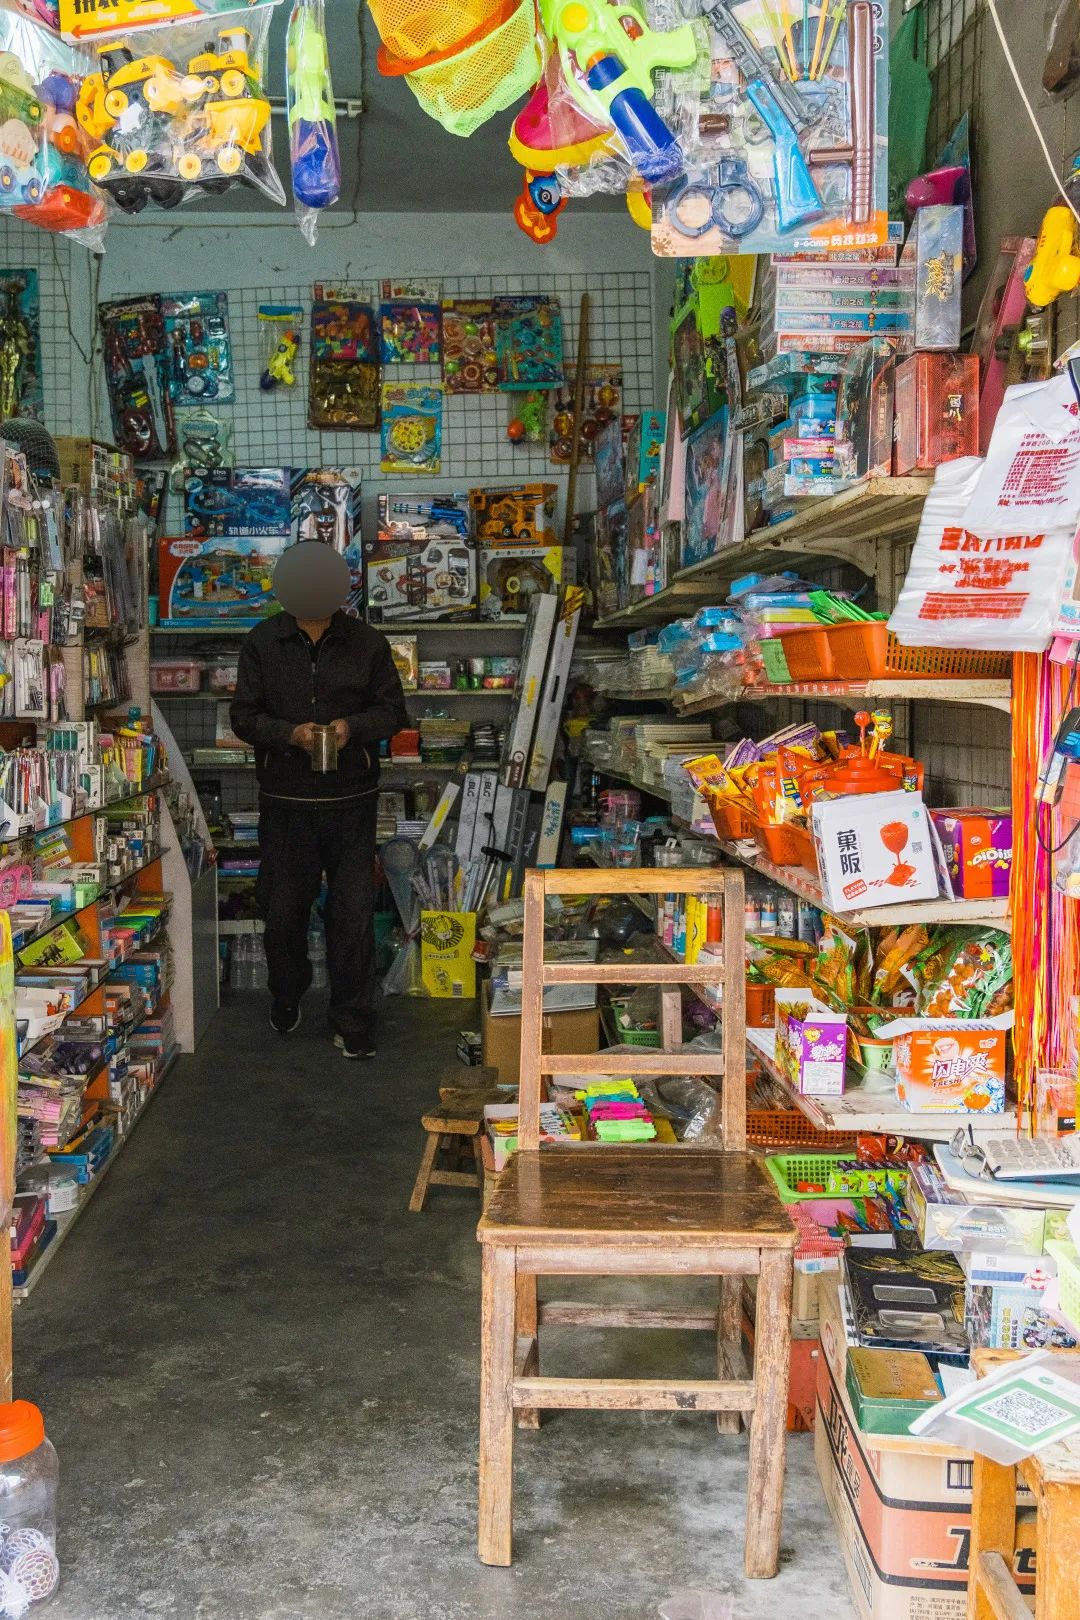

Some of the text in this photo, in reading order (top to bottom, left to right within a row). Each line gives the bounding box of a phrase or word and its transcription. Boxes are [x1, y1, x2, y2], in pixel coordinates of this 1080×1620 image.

[228, 526, 279, 536] 轨道小火车
[931, 1051, 990, 1083] 闪电爽
